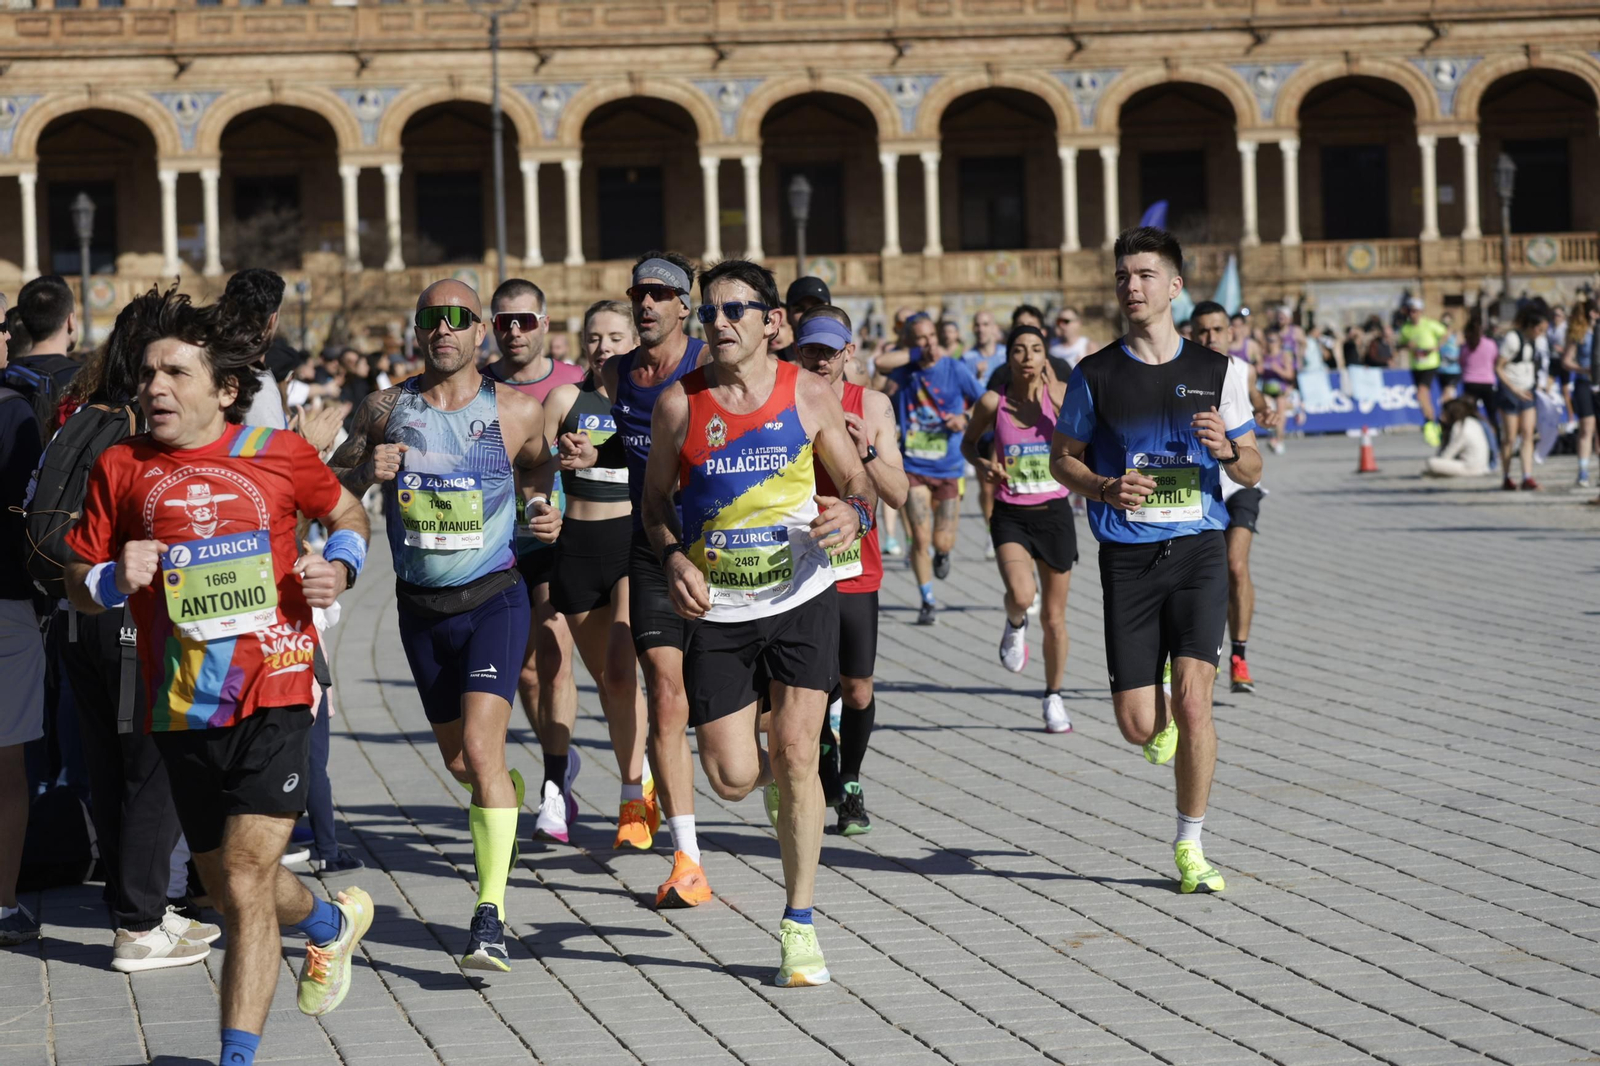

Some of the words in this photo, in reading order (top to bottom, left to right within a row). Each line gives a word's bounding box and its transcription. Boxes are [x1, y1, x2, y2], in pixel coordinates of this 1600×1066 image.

[650, 266, 682, 288] TERRE
[755, 446, 788, 455] ATLETISMO
[706, 454, 788, 475] PALACIEGO
[1154, 456, 1193, 465] ZURICH
[1155, 476, 1177, 486] 2695
[1145, 490, 1185, 504] CYRIL
[429, 500, 452, 510] 1486
[439, 520, 482, 531] MANUEL
[732, 532, 777, 544] ZURICH
[198, 538, 258, 559] ZURICH
[734, 556, 760, 567] 2487
[836, 548, 860, 565] MAX
[204, 571, 237, 587] 1669
[710, 568, 792, 587] CABALLITO
[181, 585, 266, 618] ANTONIO
[260, 634, 314, 657] NING
